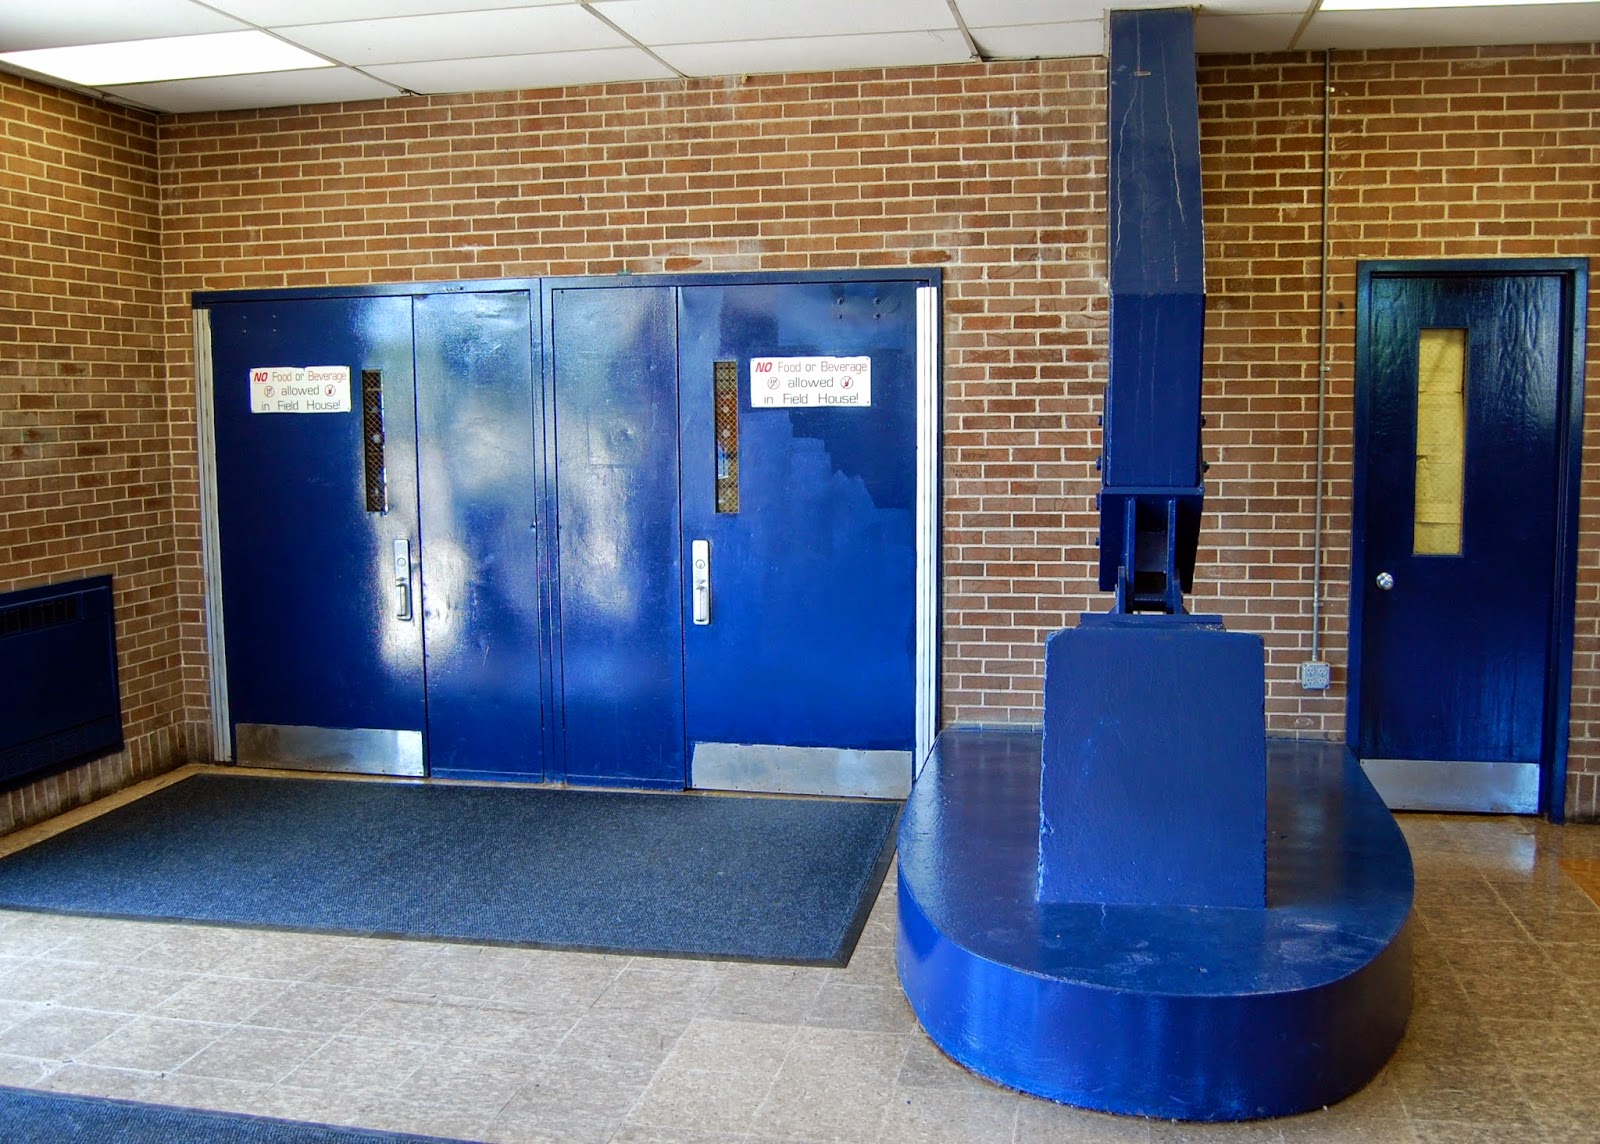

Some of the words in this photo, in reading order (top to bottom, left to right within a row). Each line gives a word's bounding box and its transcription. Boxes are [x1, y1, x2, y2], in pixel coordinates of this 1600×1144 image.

[755, 362, 772, 372] NO
[778, 362, 801, 372] Food
[805, 364, 816, 372] or
[821, 361, 867, 375] Beverage
[254, 372, 268, 382] NO
[272, 372, 292, 381] Food
[295, 373, 304, 381] or
[308, 371, 346, 383] Beverage
[788, 377, 833, 388] allowed
[281, 385, 319, 395] allowed
[764, 396, 773, 404] in
[783, 393, 808, 404] Field
[819, 393, 858, 404] House!
[262, 401, 270, 410] in
[278, 400, 298, 410] Field
[307, 400, 340, 410] House!
